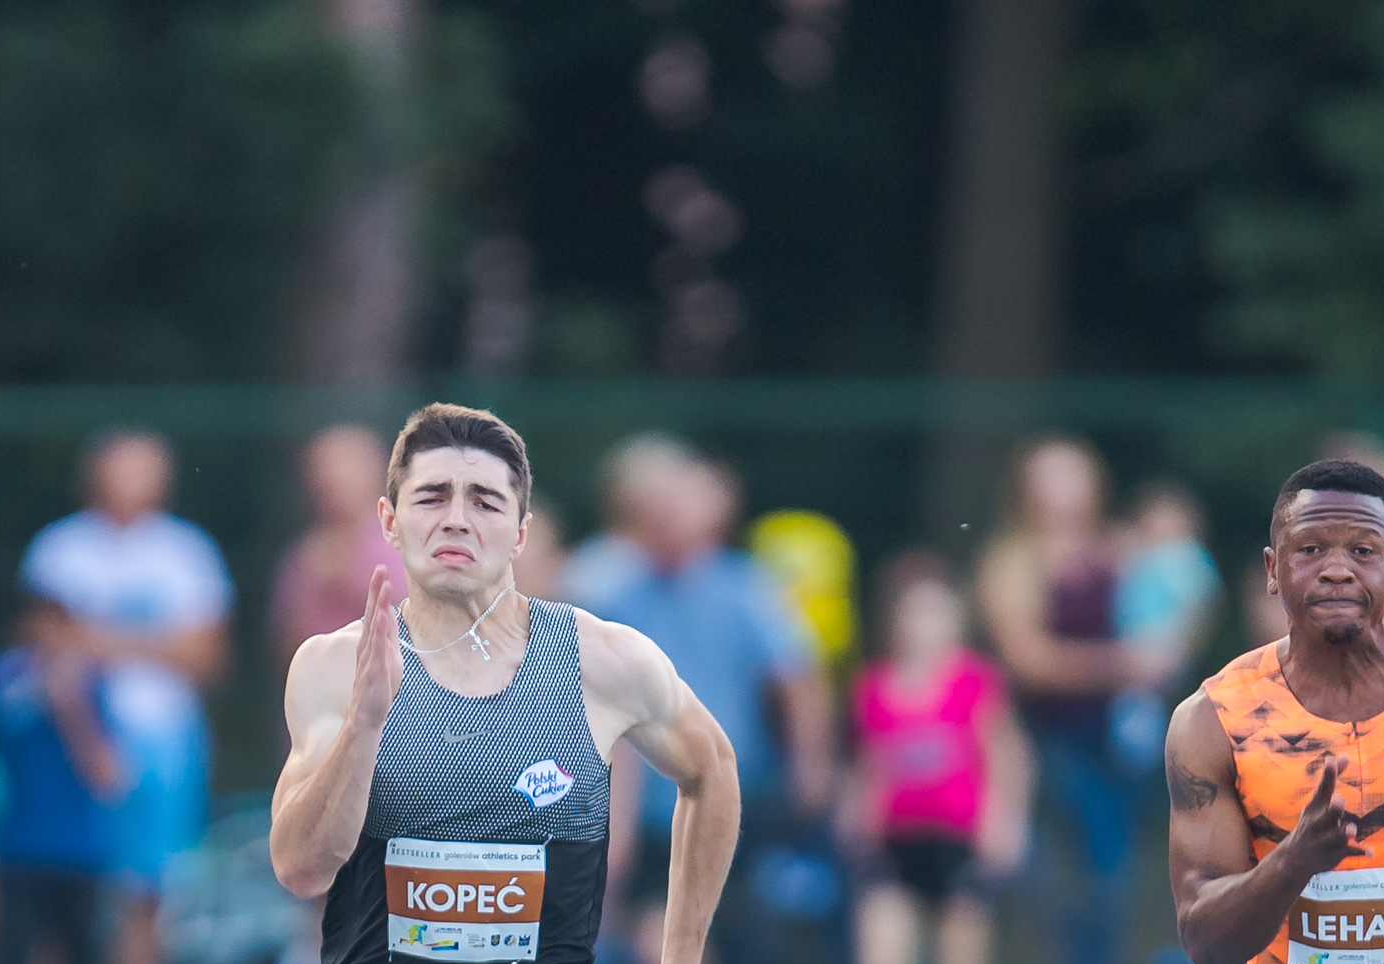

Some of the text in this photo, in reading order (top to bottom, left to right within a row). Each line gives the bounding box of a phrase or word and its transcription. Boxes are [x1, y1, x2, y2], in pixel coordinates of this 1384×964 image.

[524, 769, 558, 789] Polski
[532, 781, 568, 799] Cukier
[391, 847, 541, 862] BESTSELLER goleniów athletics park
[407, 877, 526, 914] KOPEĆ
